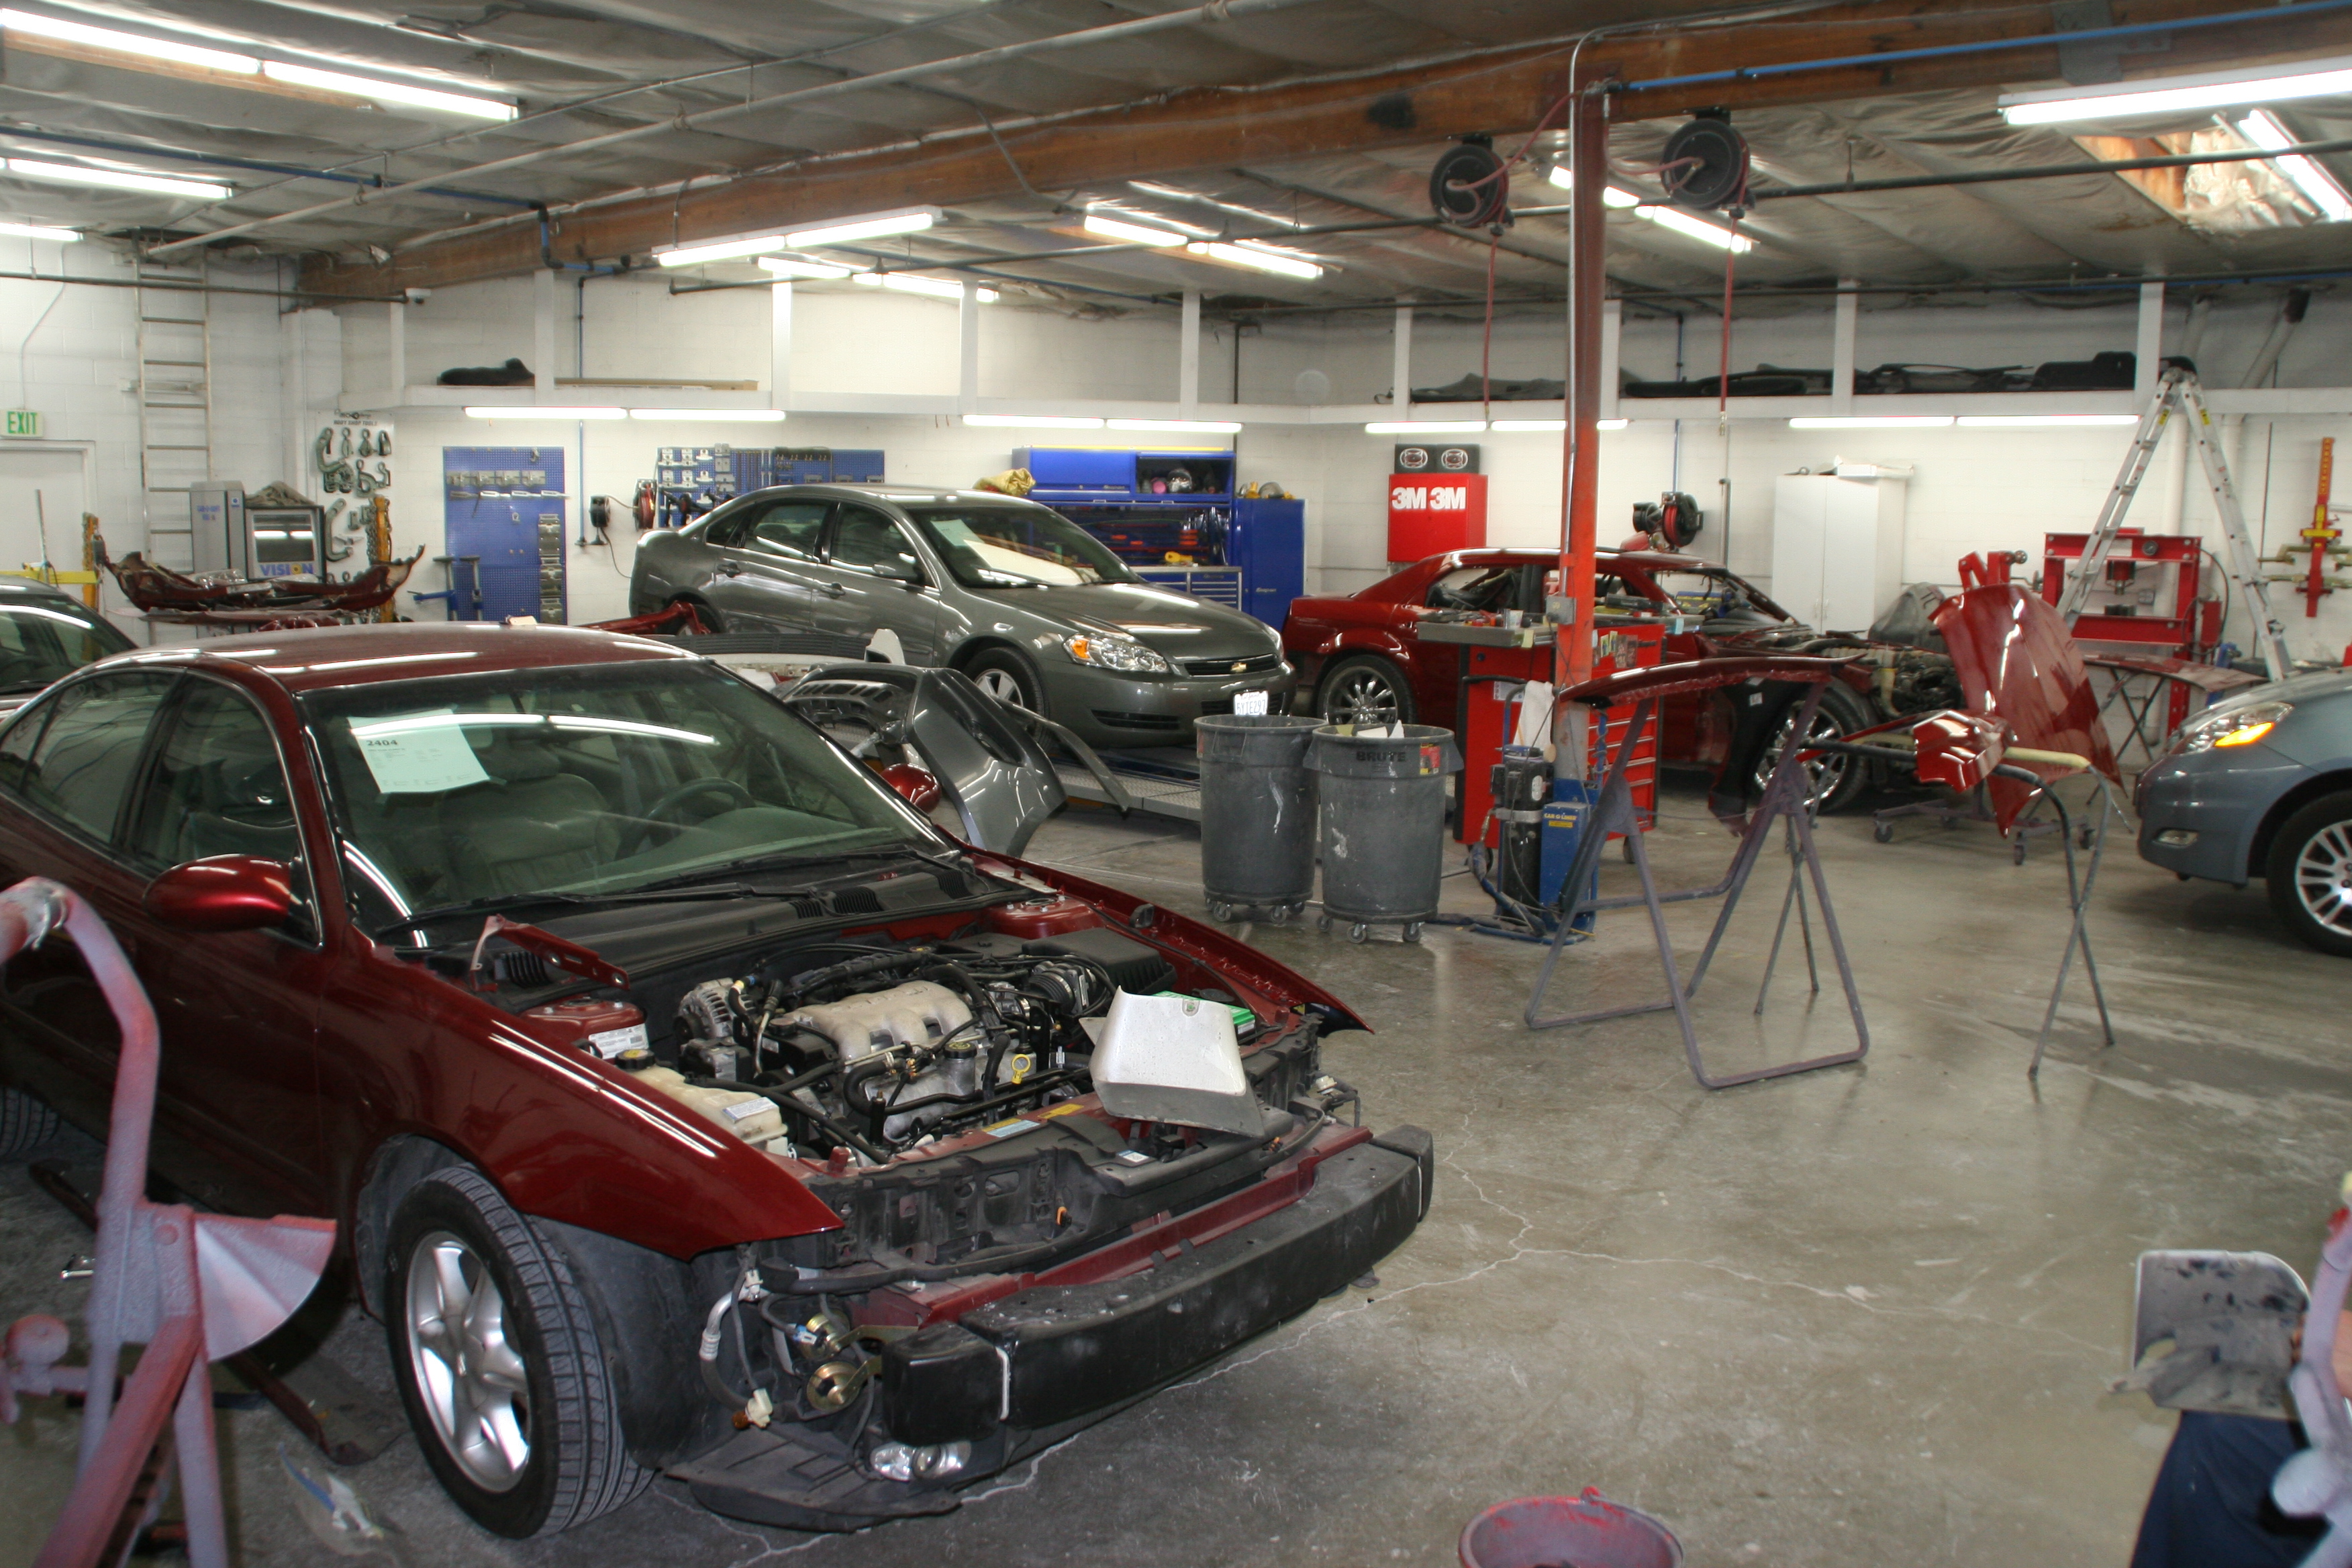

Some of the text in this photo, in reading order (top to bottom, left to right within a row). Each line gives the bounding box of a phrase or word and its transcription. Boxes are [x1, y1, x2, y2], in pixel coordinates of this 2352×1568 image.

[7, 411, 37, 434] EXIT
[1391, 487, 1466, 510] 3M 3M
[260, 563, 313, 577] VISION
[1356, 751, 1407, 763] BRUTE
